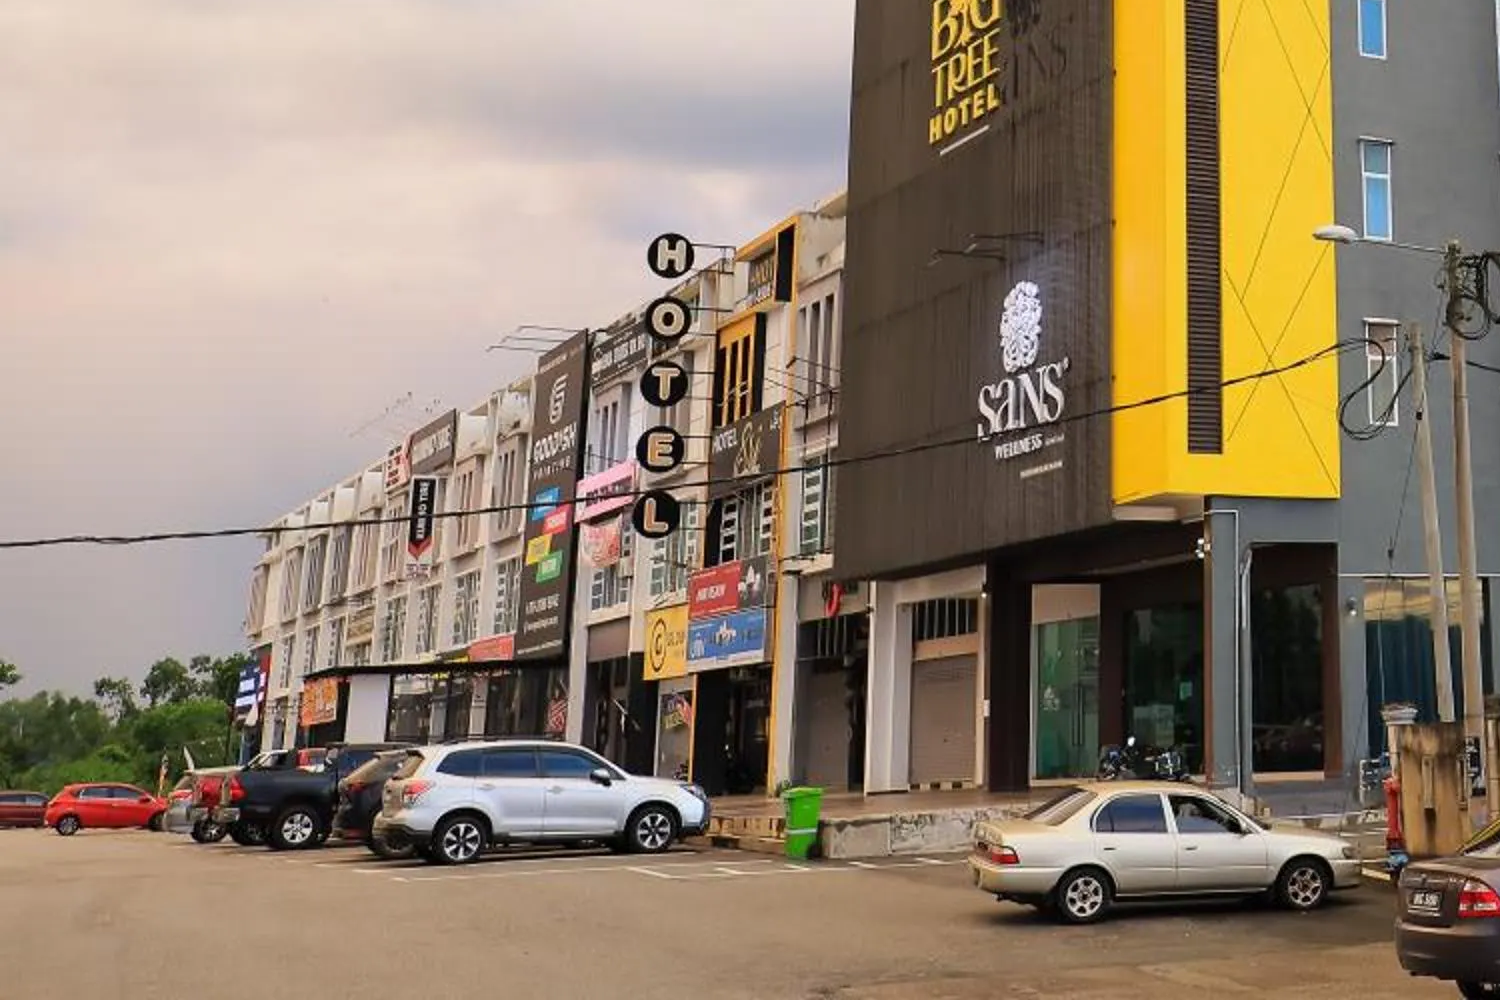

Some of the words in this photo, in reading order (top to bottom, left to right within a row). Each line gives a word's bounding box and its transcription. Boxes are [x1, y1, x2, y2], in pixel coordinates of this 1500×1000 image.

[932, 27, 1002, 108] TREE
[929, 84, 1000, 145] HOTEL
[644, 237, 687, 533] HOTEL
[994, 432, 1044, 460] WELLNESS
